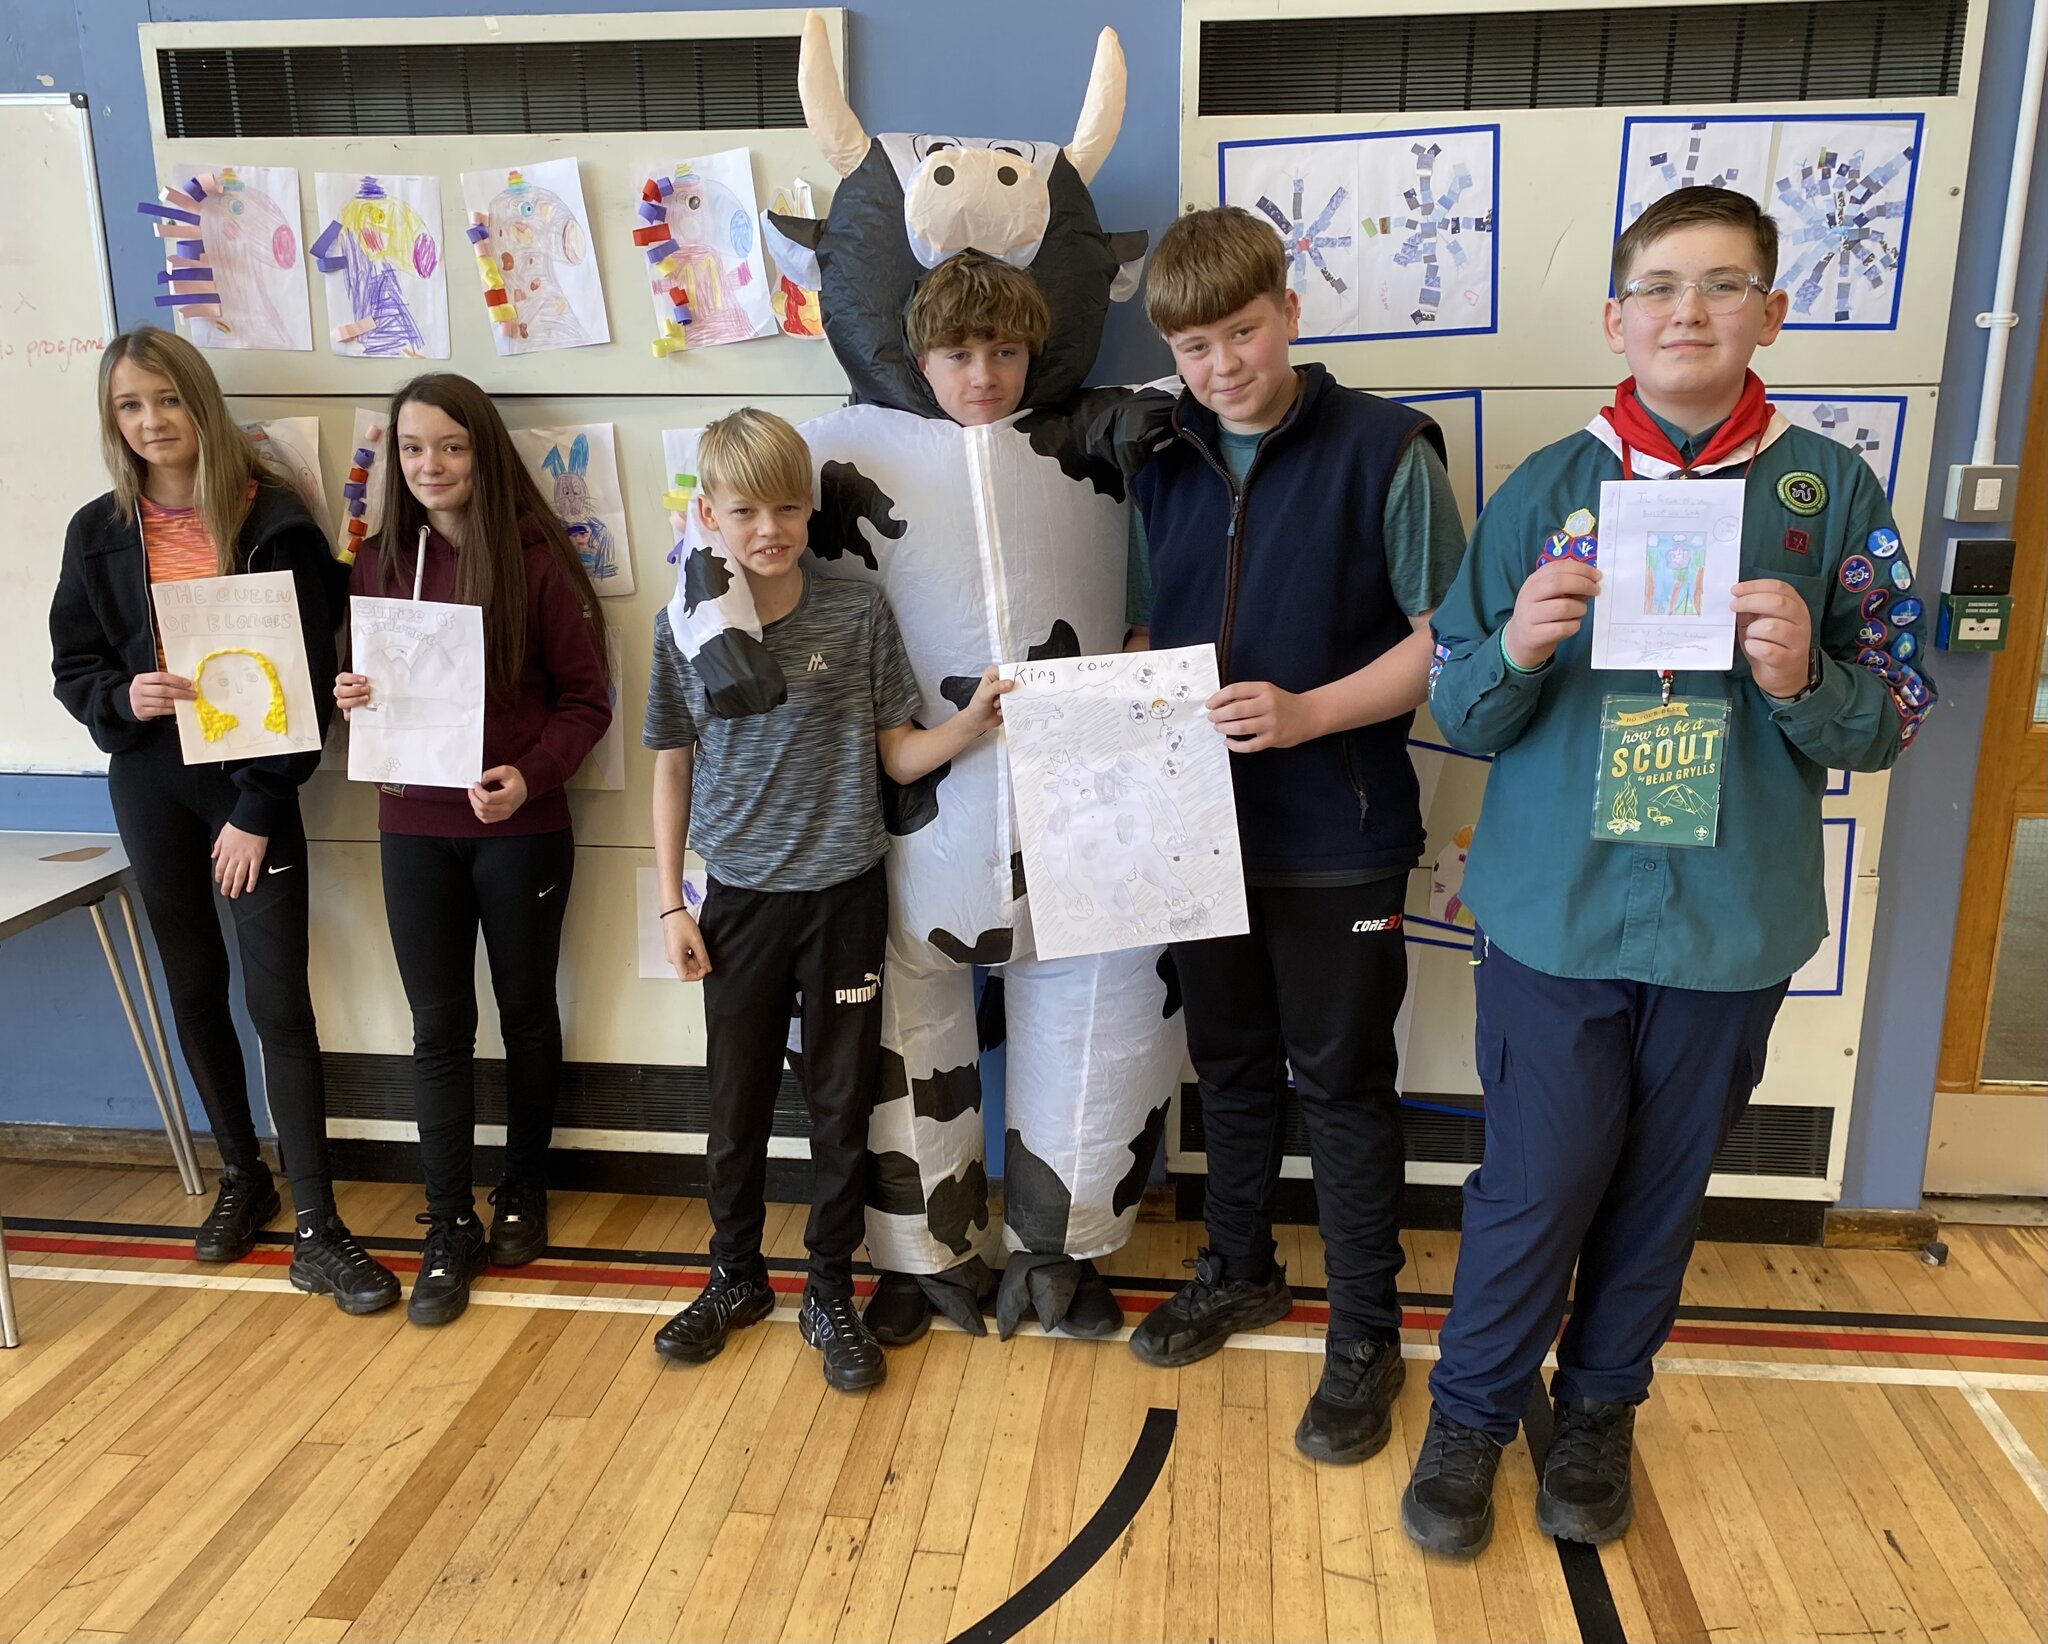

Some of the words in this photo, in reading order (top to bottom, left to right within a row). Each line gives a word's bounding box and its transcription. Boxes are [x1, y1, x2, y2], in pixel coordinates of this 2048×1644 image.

[157, 584, 207, 605] THE
[215, 587, 292, 603] QUEEN
[163, 614, 191, 633] OF
[1012, 664, 1056, 685] King
[1661, 706, 1681, 714] BEST
[1621, 730, 1652, 745] how
[1655, 724, 1670, 738] to
[1673, 719, 1690, 735] be
[1692, 720, 1704, 731] a
[1611, 729, 1720, 778] SCOUT
[1645, 771, 1673, 786] BEAR
[1675, 763, 1716, 781] GRYLLS
[835, 983, 877, 1004] PUMA
